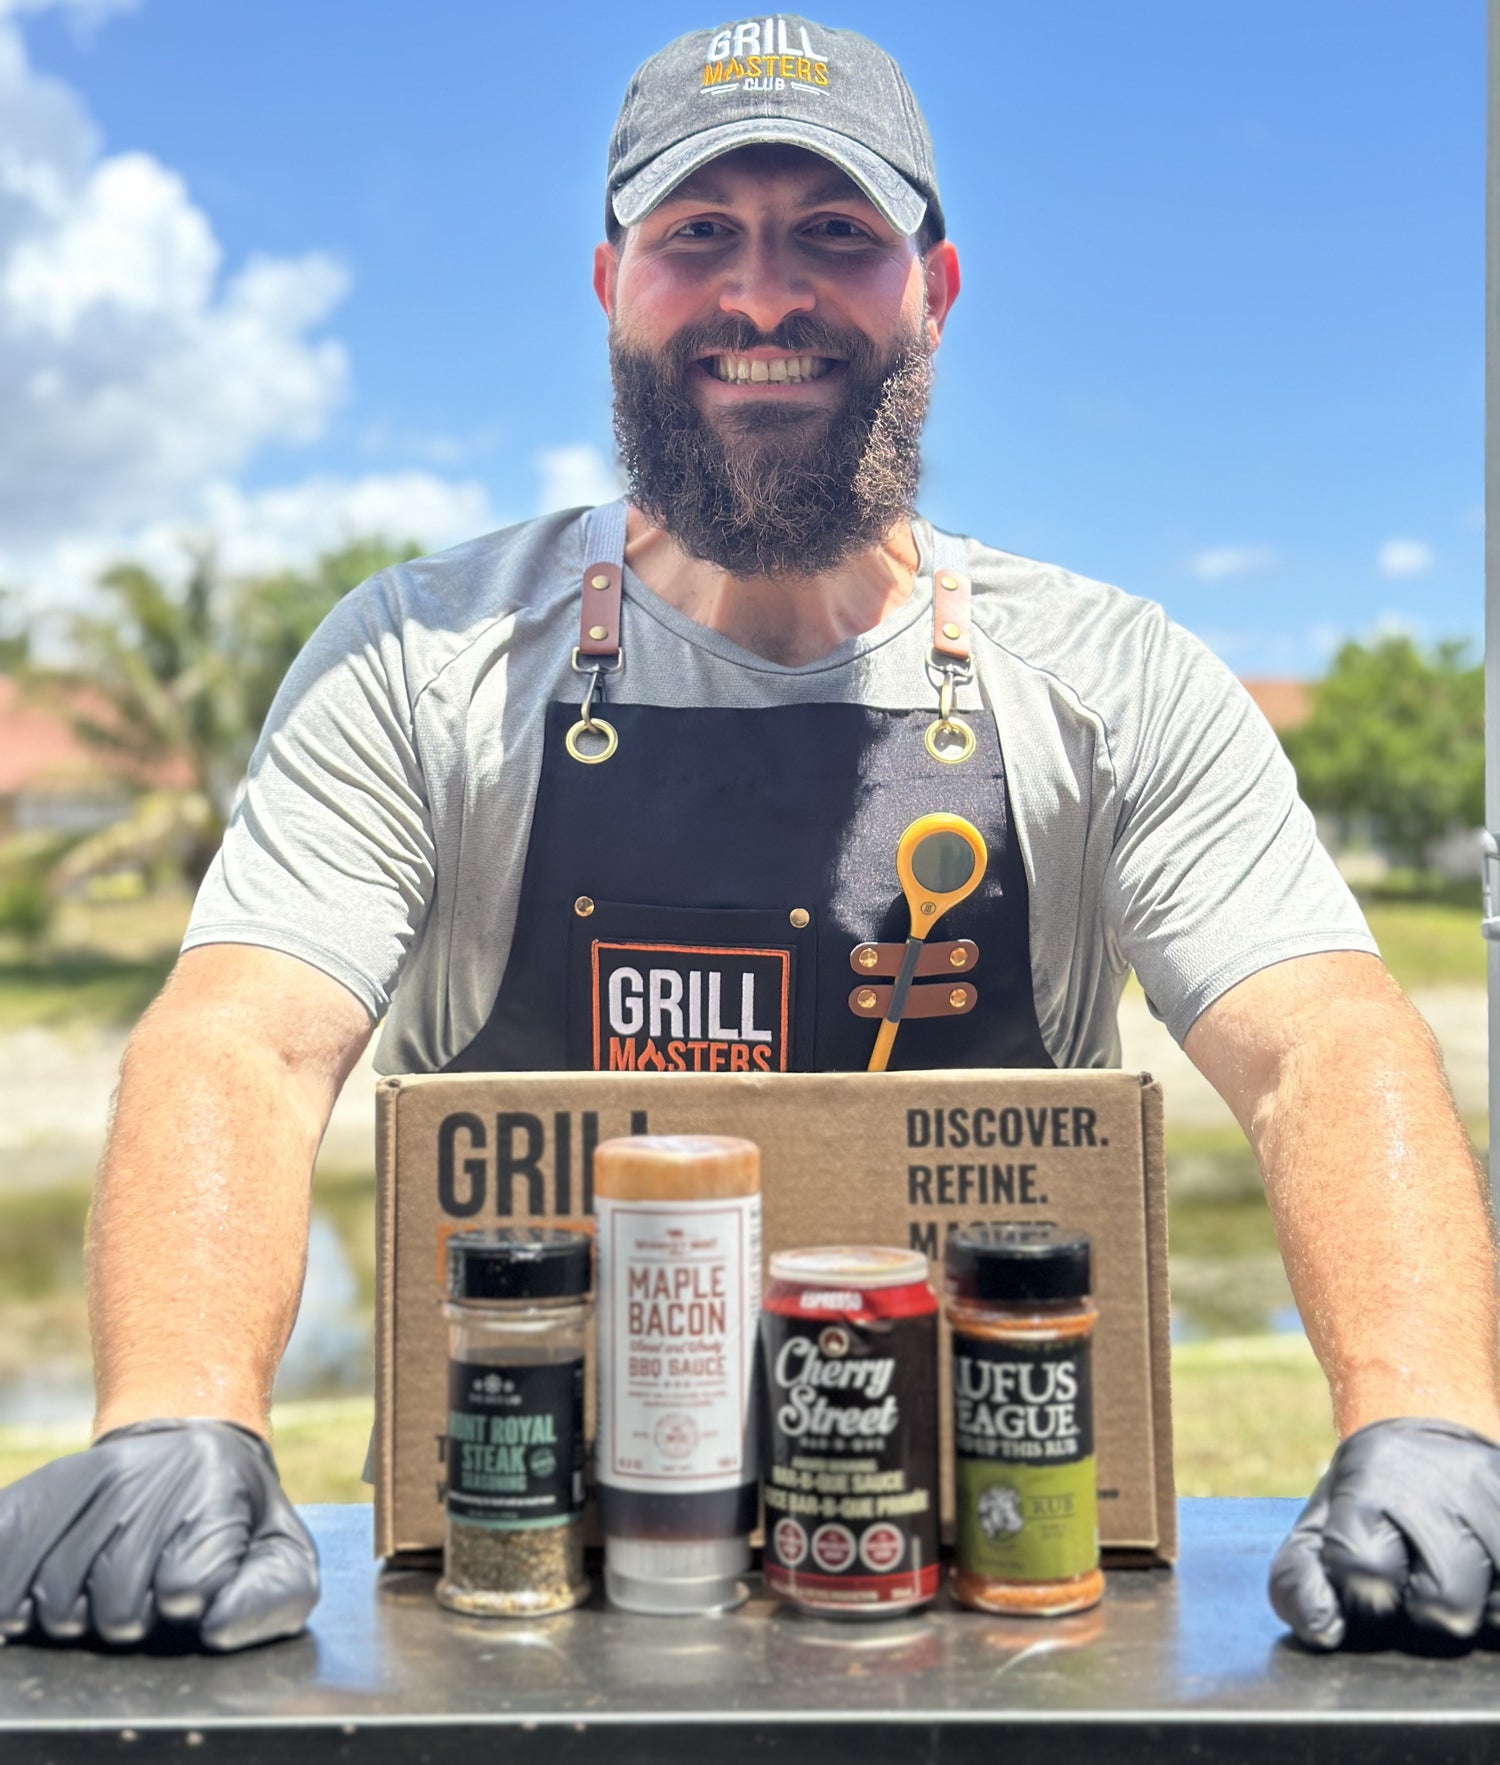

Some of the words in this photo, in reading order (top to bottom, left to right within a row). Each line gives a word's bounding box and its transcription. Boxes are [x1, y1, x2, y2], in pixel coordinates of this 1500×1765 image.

[706, 17, 828, 63] GRILL
[702, 55, 829, 87] MASTERS
[743, 78, 785, 90] CLUB
[608, 966, 772, 1042] GRILL
[609, 1037, 772, 1071] MASTERS
[906, 1106, 1109, 1148] DISCOVER.
[437, 1110, 648, 1218] GRIL
[907, 1164, 1049, 1205] REFINE.
[628, 1265, 726, 1300] MAPLE
[628, 1301, 726, 1337] BACON
[627, 1356, 662, 1379] BBQ
[668, 1356, 727, 1378] SAUCE
[774, 1336, 896, 1399] Cherry
[777, 1384, 899, 1437] Street
[957, 1402, 1079, 1440] EAGUE
[490, 1413, 558, 1445] ROYAL
[461, 1443, 528, 1474] STEAK
[1002, 1438, 1043, 1458] THIS
[1045, 1437, 1079, 1458] RUB
[851, 1469, 906, 1494] SAUCE
[1032, 1498, 1075, 1515] RUB
